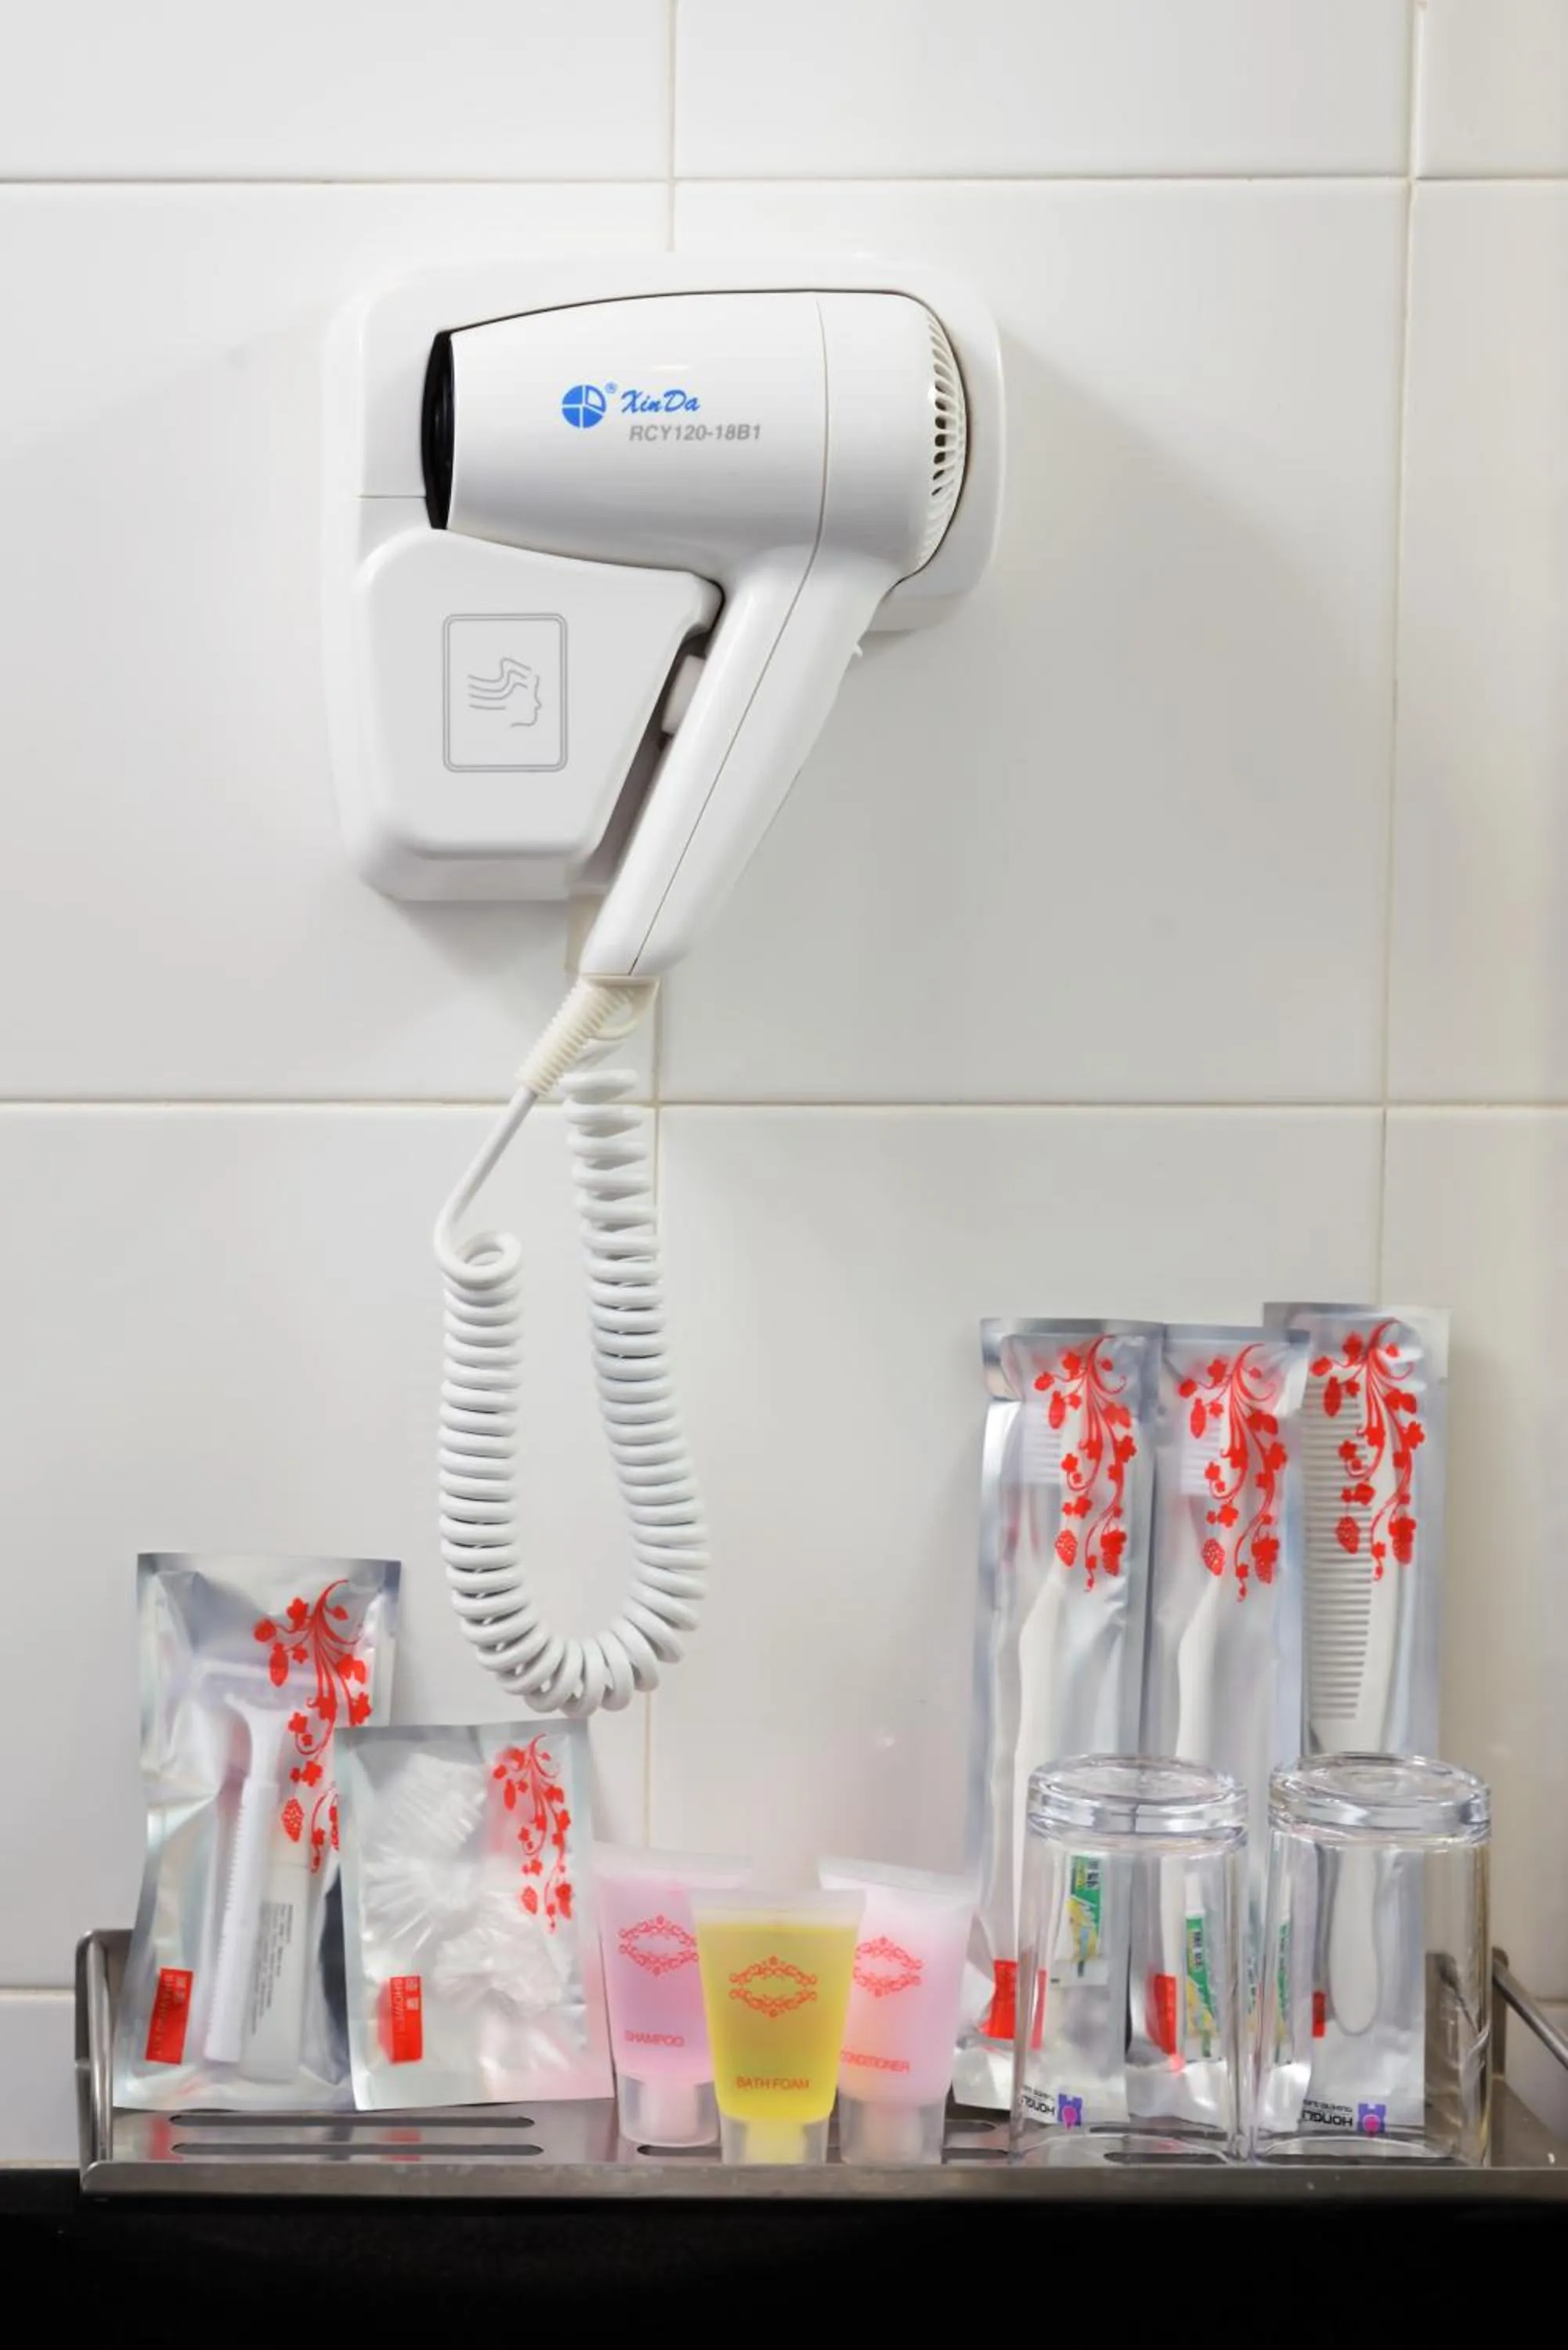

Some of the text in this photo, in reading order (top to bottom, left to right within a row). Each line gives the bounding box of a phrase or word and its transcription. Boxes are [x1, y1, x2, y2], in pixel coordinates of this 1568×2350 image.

[621, 389, 699, 413] XinDa
[629, 424, 761, 442] RCY120-18B1
[625, 2030, 685, 2048] SHAMPOO
[840, 2049, 910, 2076] ONDITIONER
[736, 2076, 810, 2091] BATH FOAM
